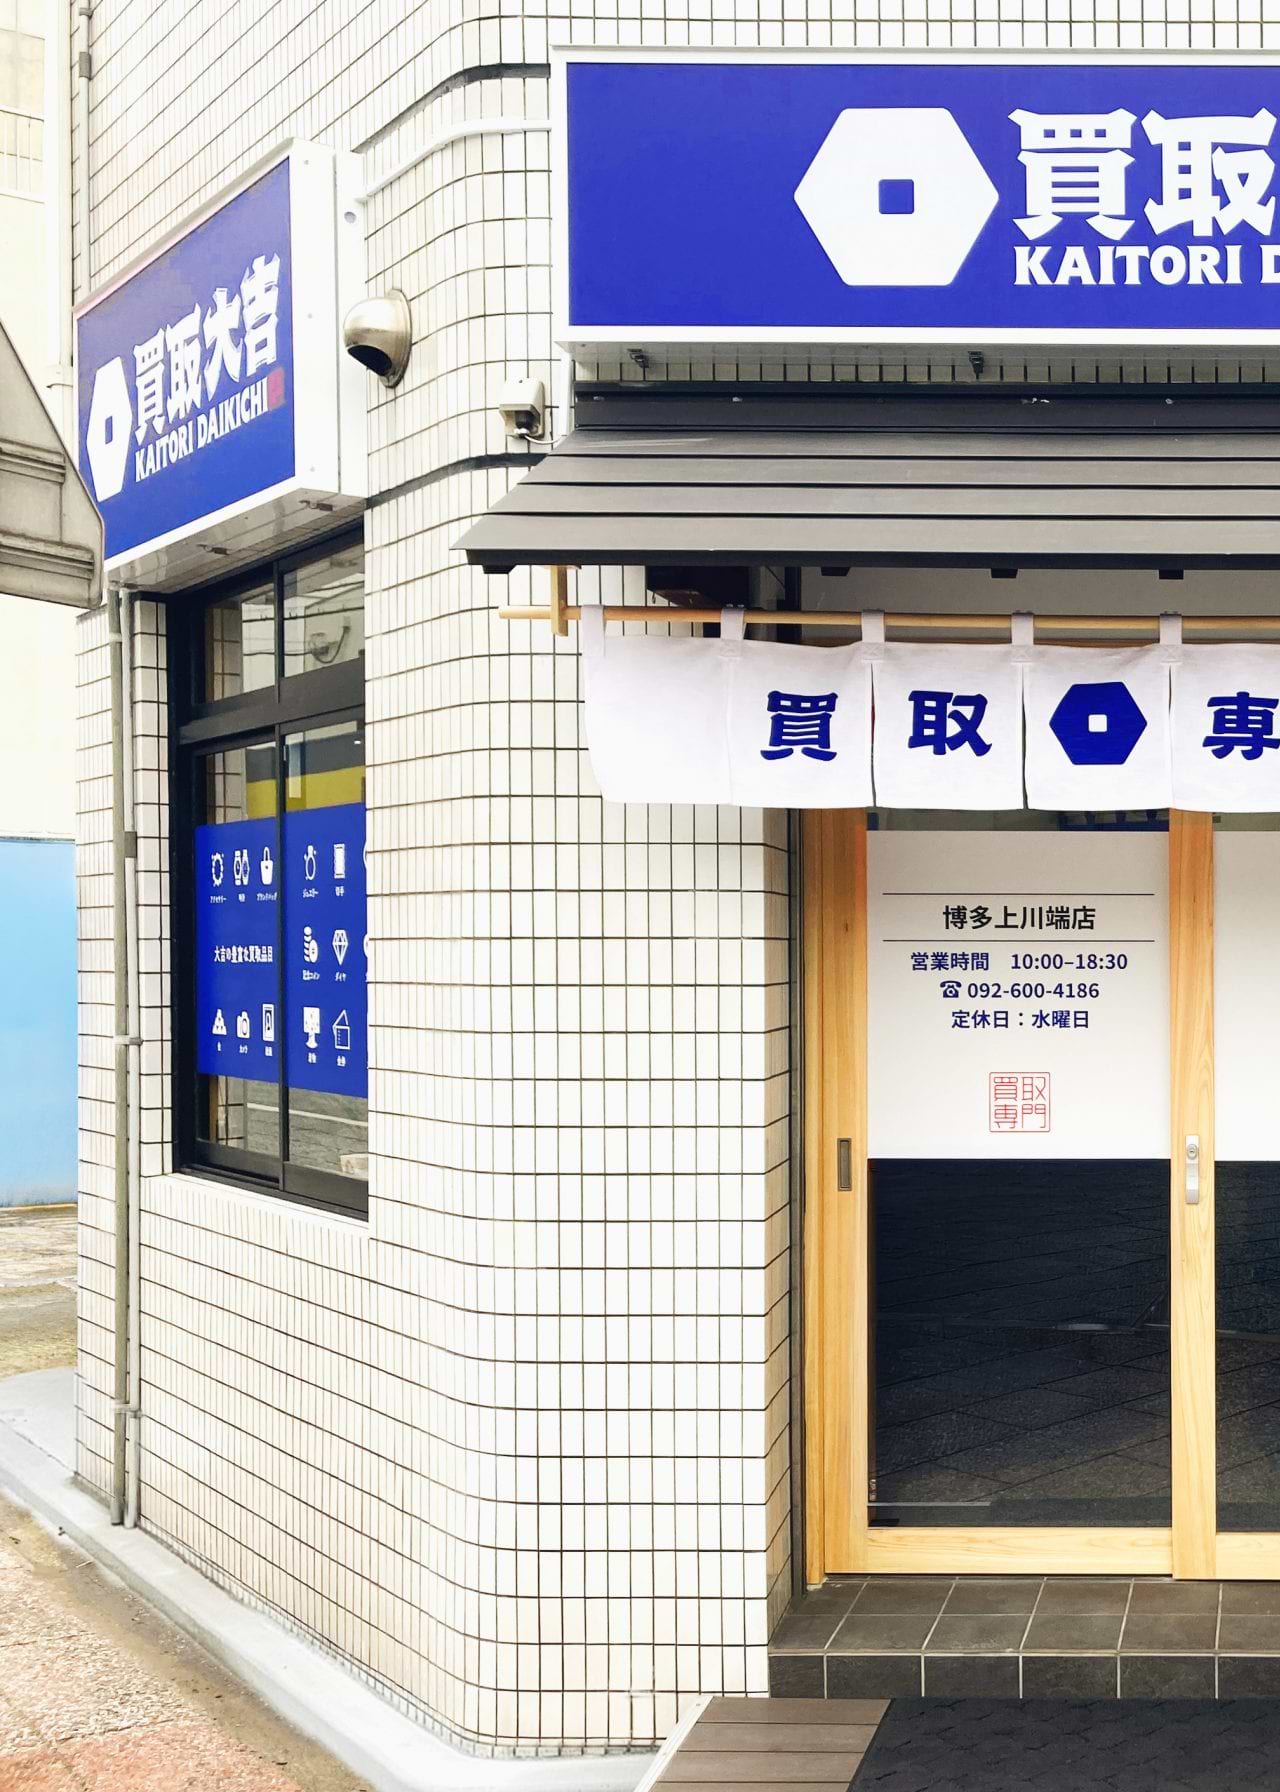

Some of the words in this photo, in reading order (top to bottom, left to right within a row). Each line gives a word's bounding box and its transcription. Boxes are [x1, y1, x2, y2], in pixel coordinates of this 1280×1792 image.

[1013, 245, 1244, 286] KAITORI
[133, 252, 281, 446] 買取大吉
[134, 425, 193, 483] KAITORI
[197, 377, 269, 450] DAIKICHI
[942, 905, 1096, 930] 博多上川端店
[910, 952, 990, 971] 営業時間
[967, 982, 1100, 999] 092-600-4186
